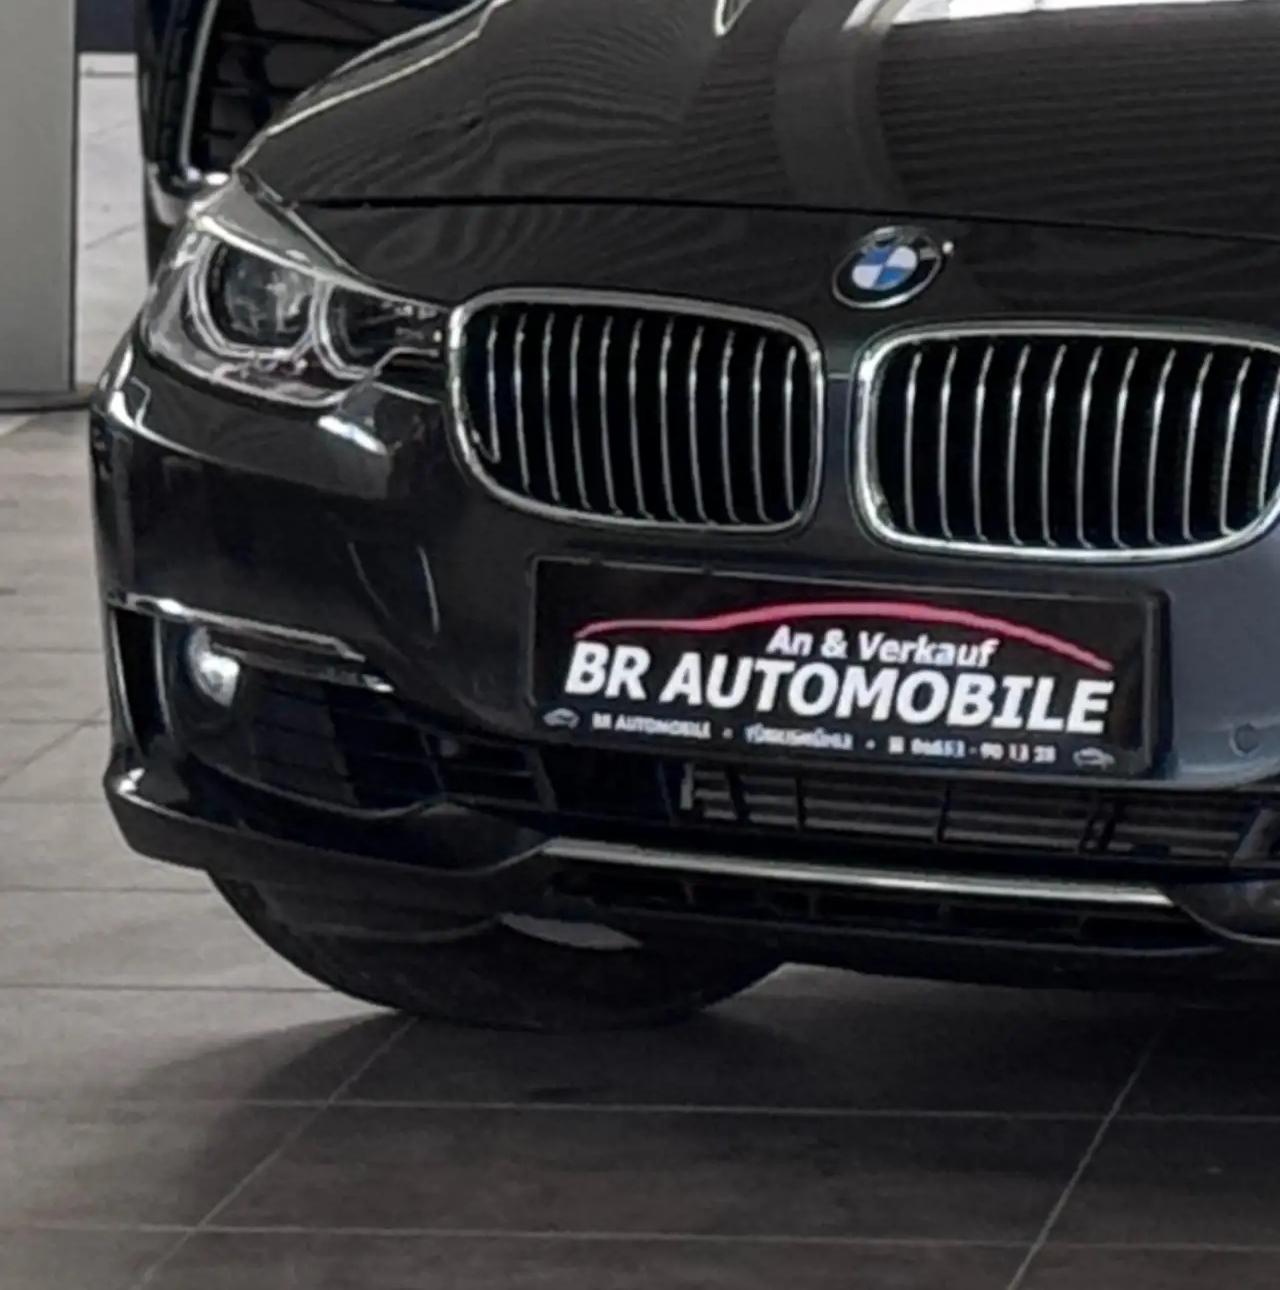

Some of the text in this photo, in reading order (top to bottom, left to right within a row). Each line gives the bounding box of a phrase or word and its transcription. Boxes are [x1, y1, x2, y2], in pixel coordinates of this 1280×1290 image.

[766, 624, 1000, 669] An & Verkauf
[564, 641, 1115, 734] BR AUTOMOBILE
